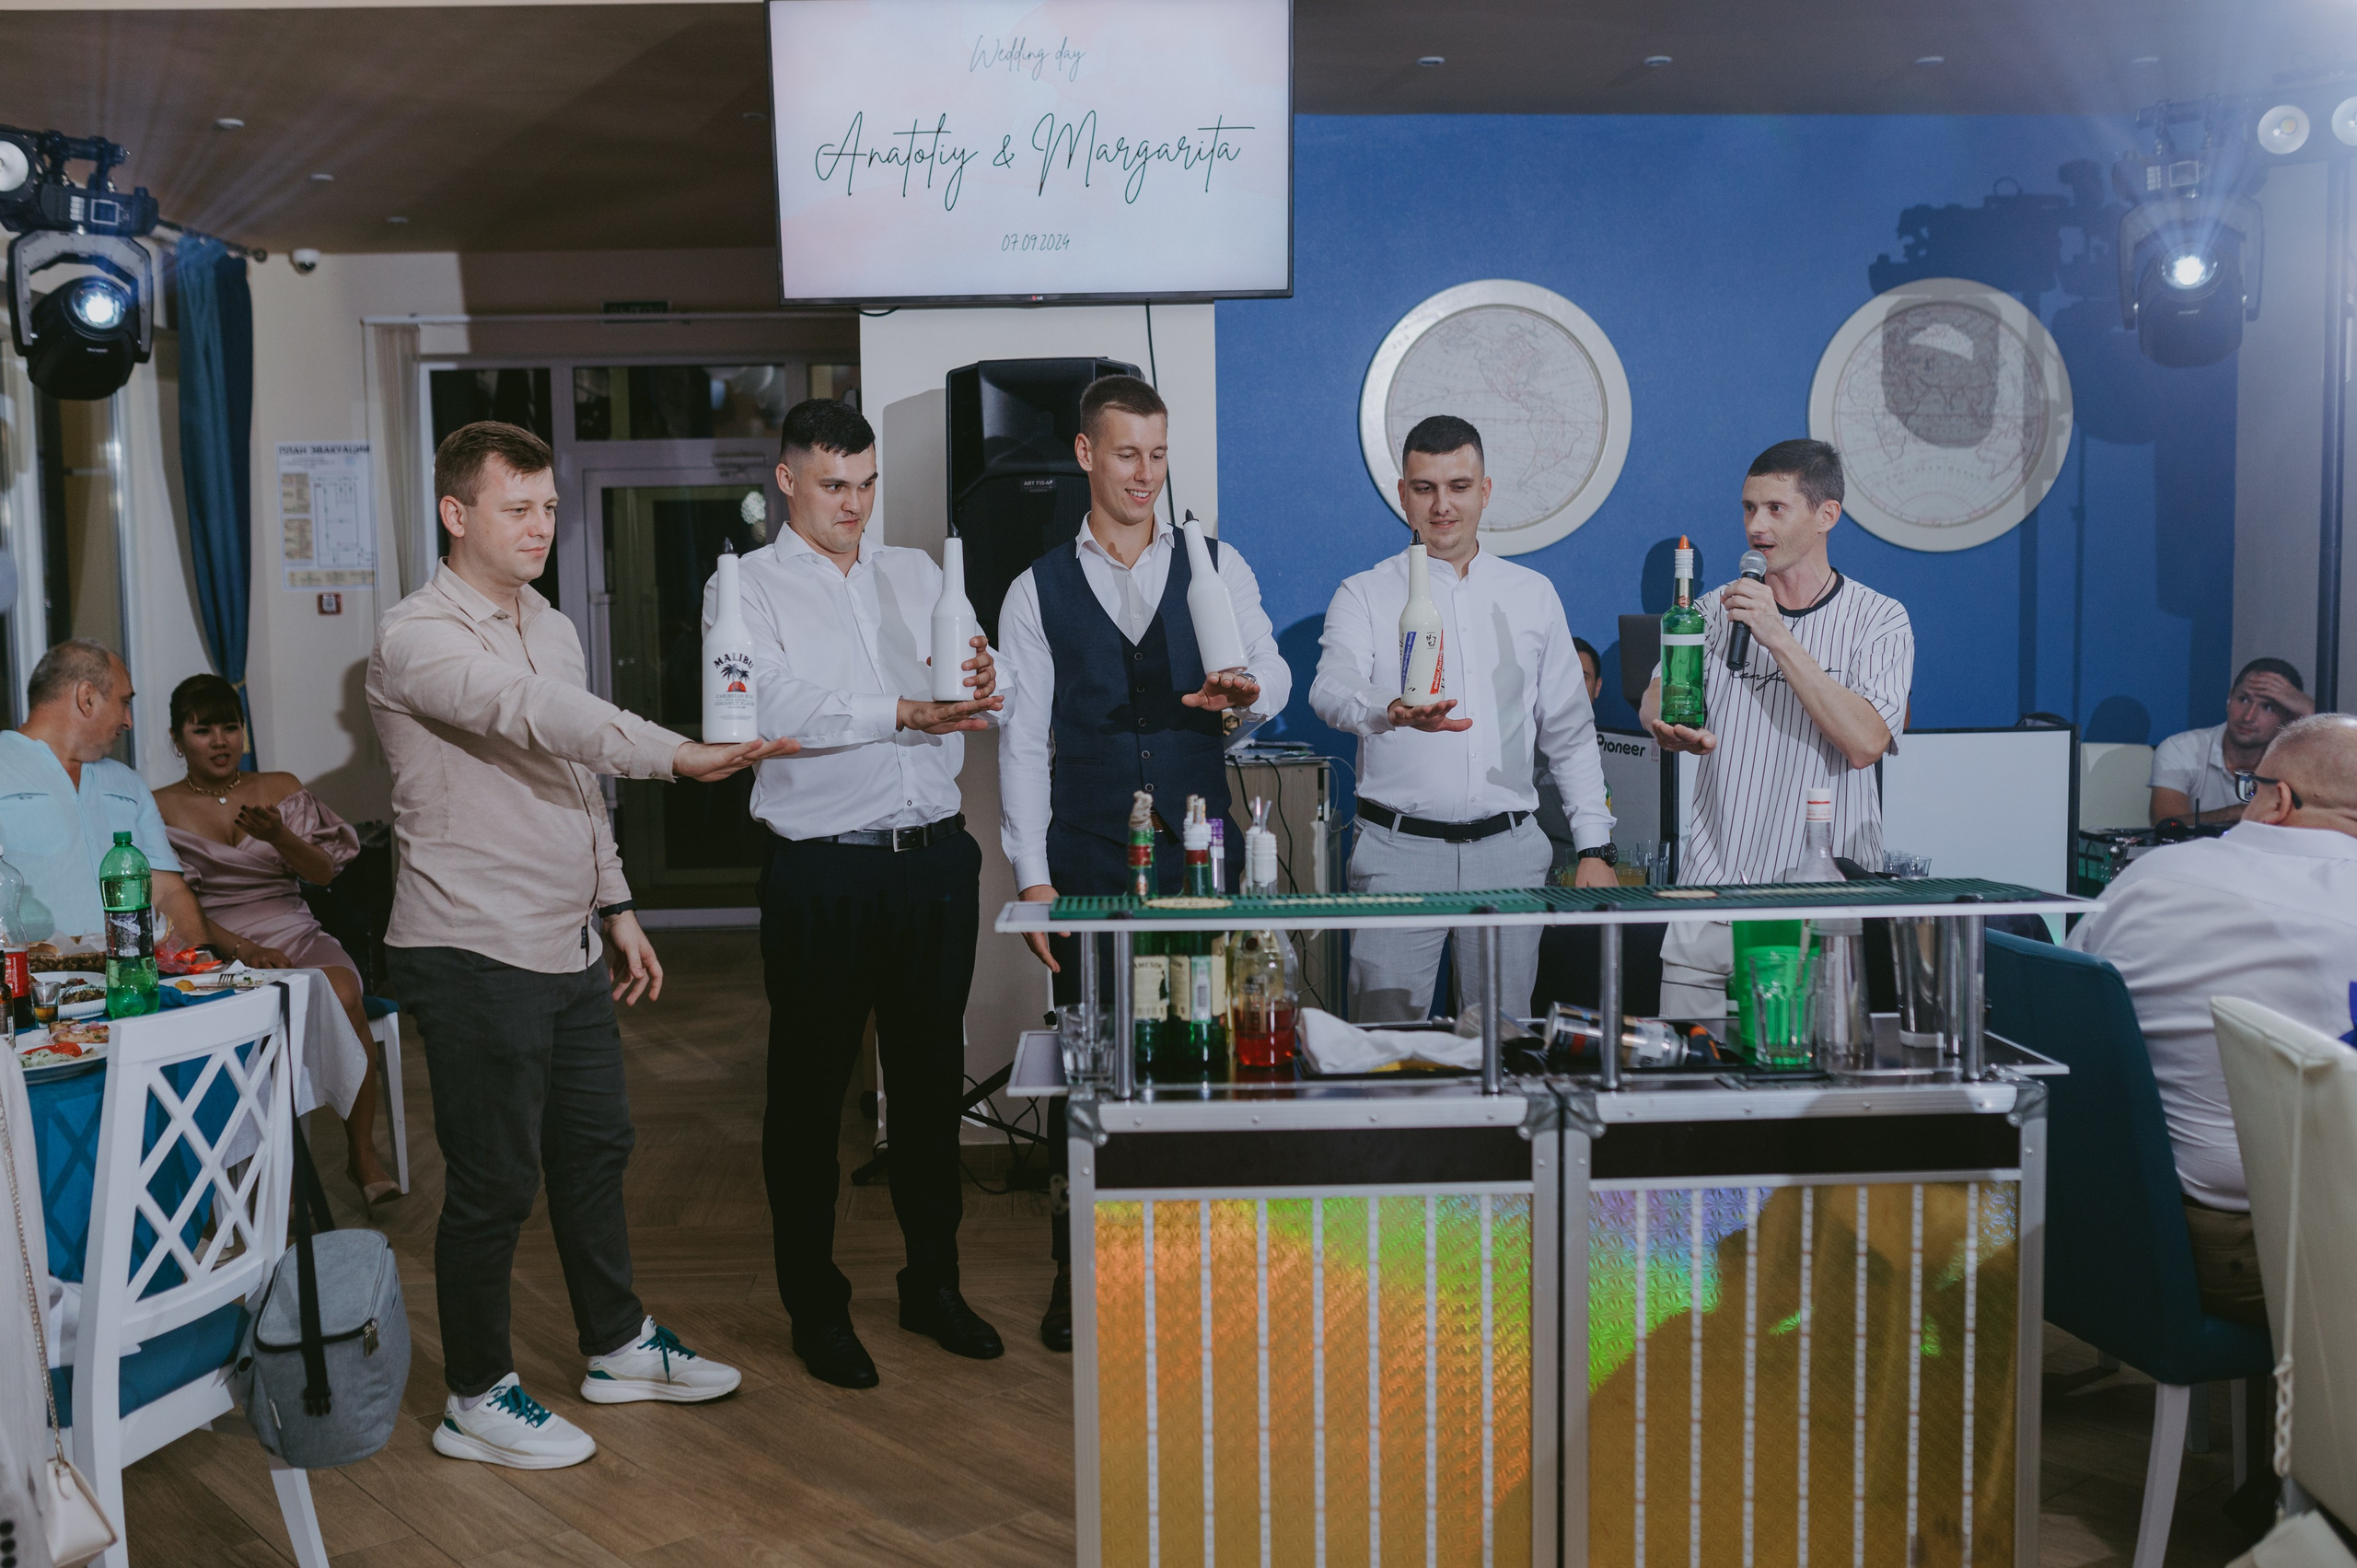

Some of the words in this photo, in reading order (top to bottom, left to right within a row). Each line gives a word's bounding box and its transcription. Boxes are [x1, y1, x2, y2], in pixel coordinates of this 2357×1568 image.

[970, 35, 1050, 81] Wedding
[1056, 37, 1086, 82] day
[993, 134, 1015, 168] &
[1031, 110, 1256, 203] Margarita
[1001, 233, 1071, 252] 07.09.2024
[714, 653, 753, 668] MALIBU
[1596, 734, 1645, 757] Pioneer
